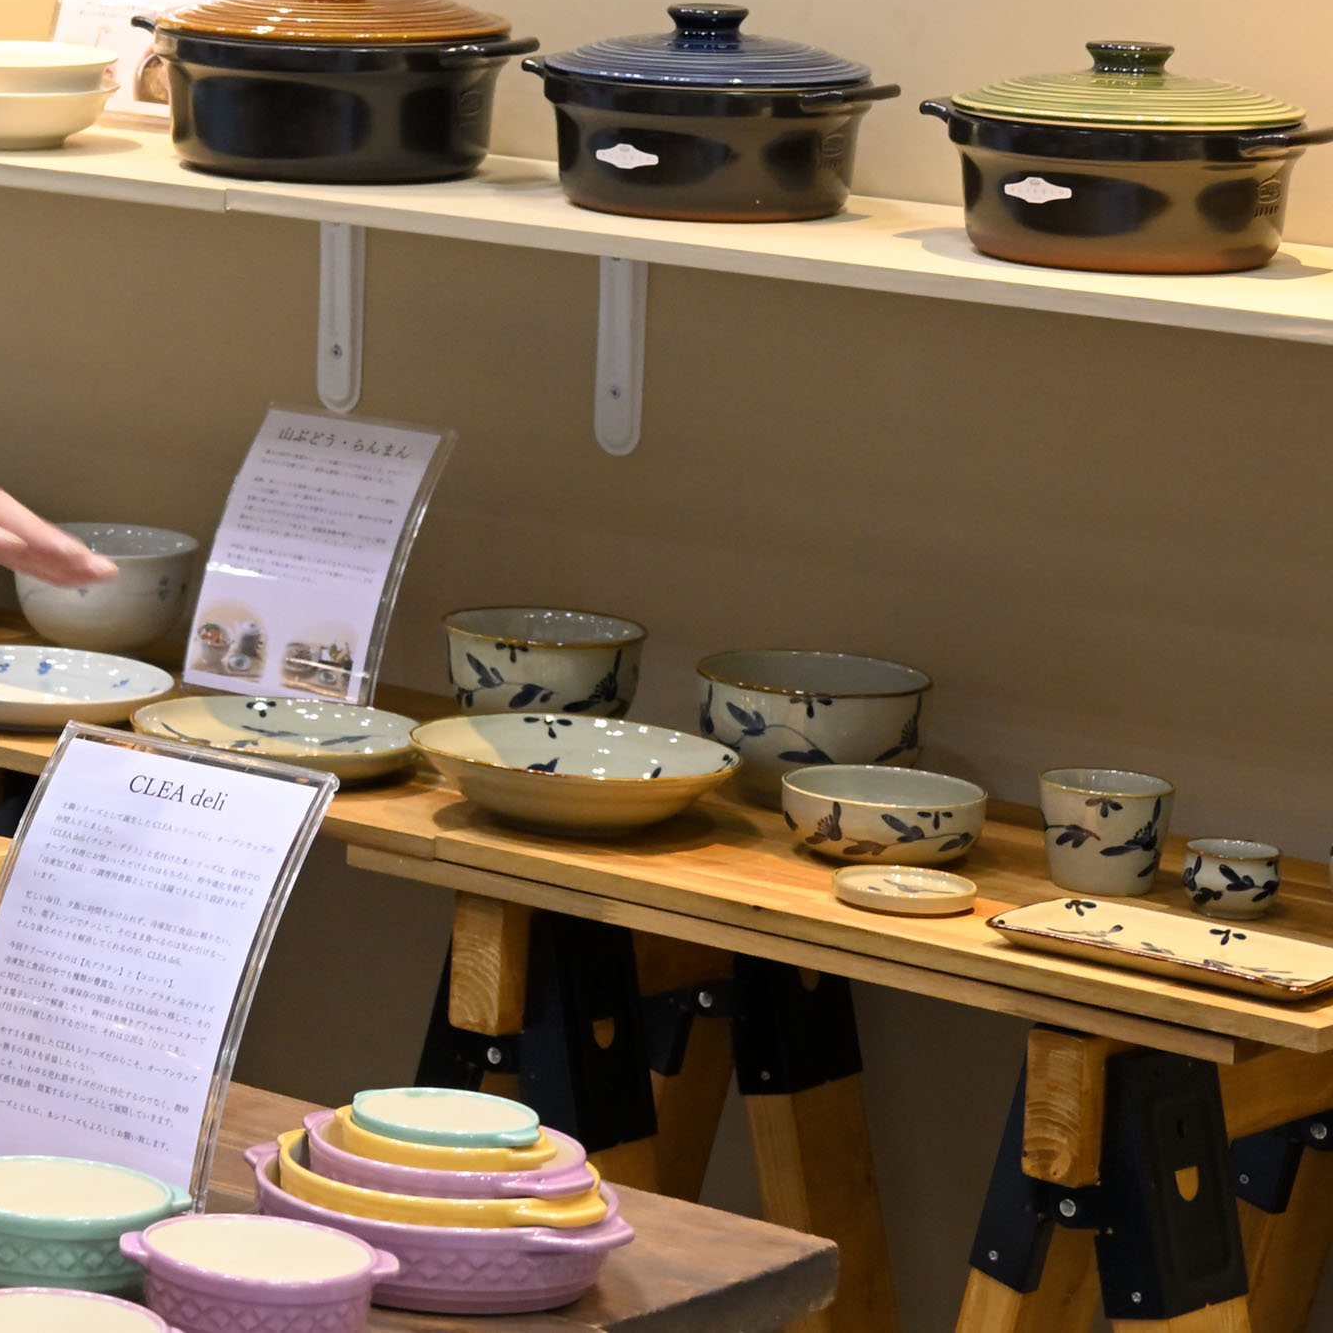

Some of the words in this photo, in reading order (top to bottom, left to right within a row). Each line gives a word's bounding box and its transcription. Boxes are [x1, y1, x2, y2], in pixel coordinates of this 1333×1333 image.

[278, 425, 411, 460] 山ぶどう・らんまん
[129, 774, 185, 804] CLEA
[190, 788, 229, 812] deli
[32, 869, 58, 882] います。
